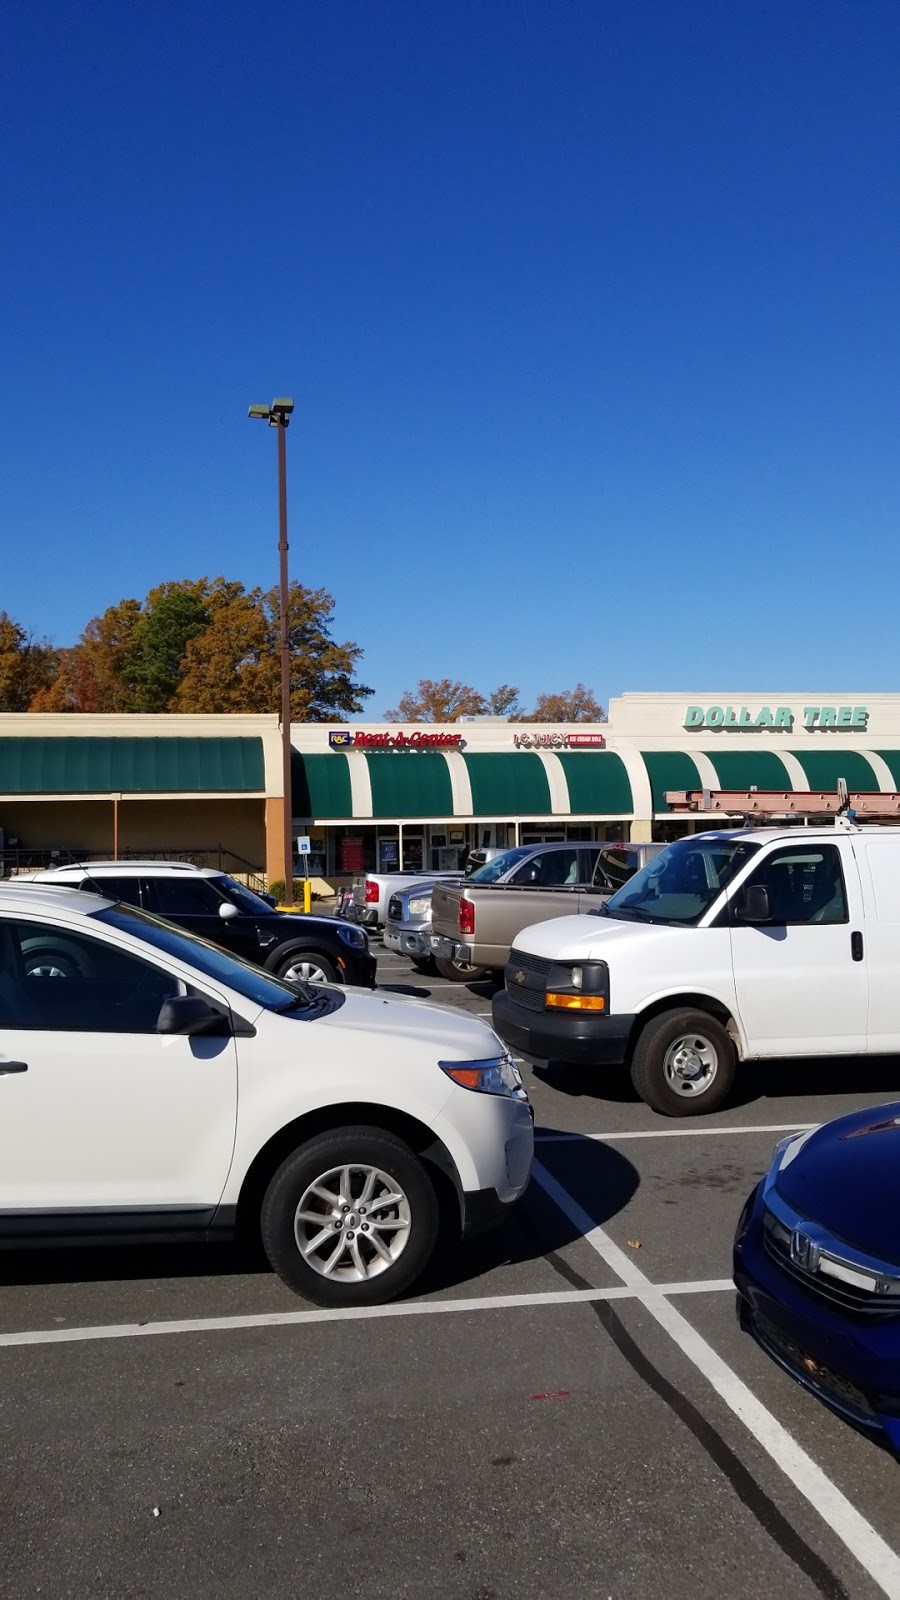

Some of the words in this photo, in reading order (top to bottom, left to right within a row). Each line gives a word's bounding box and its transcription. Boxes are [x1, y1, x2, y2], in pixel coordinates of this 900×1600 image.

[684, 706, 792, 727] DOLLAR
[803, 707, 868, 726] TREE
[331, 735, 348, 744] RAC
[353, 731, 461, 746] Rent-A-Center
